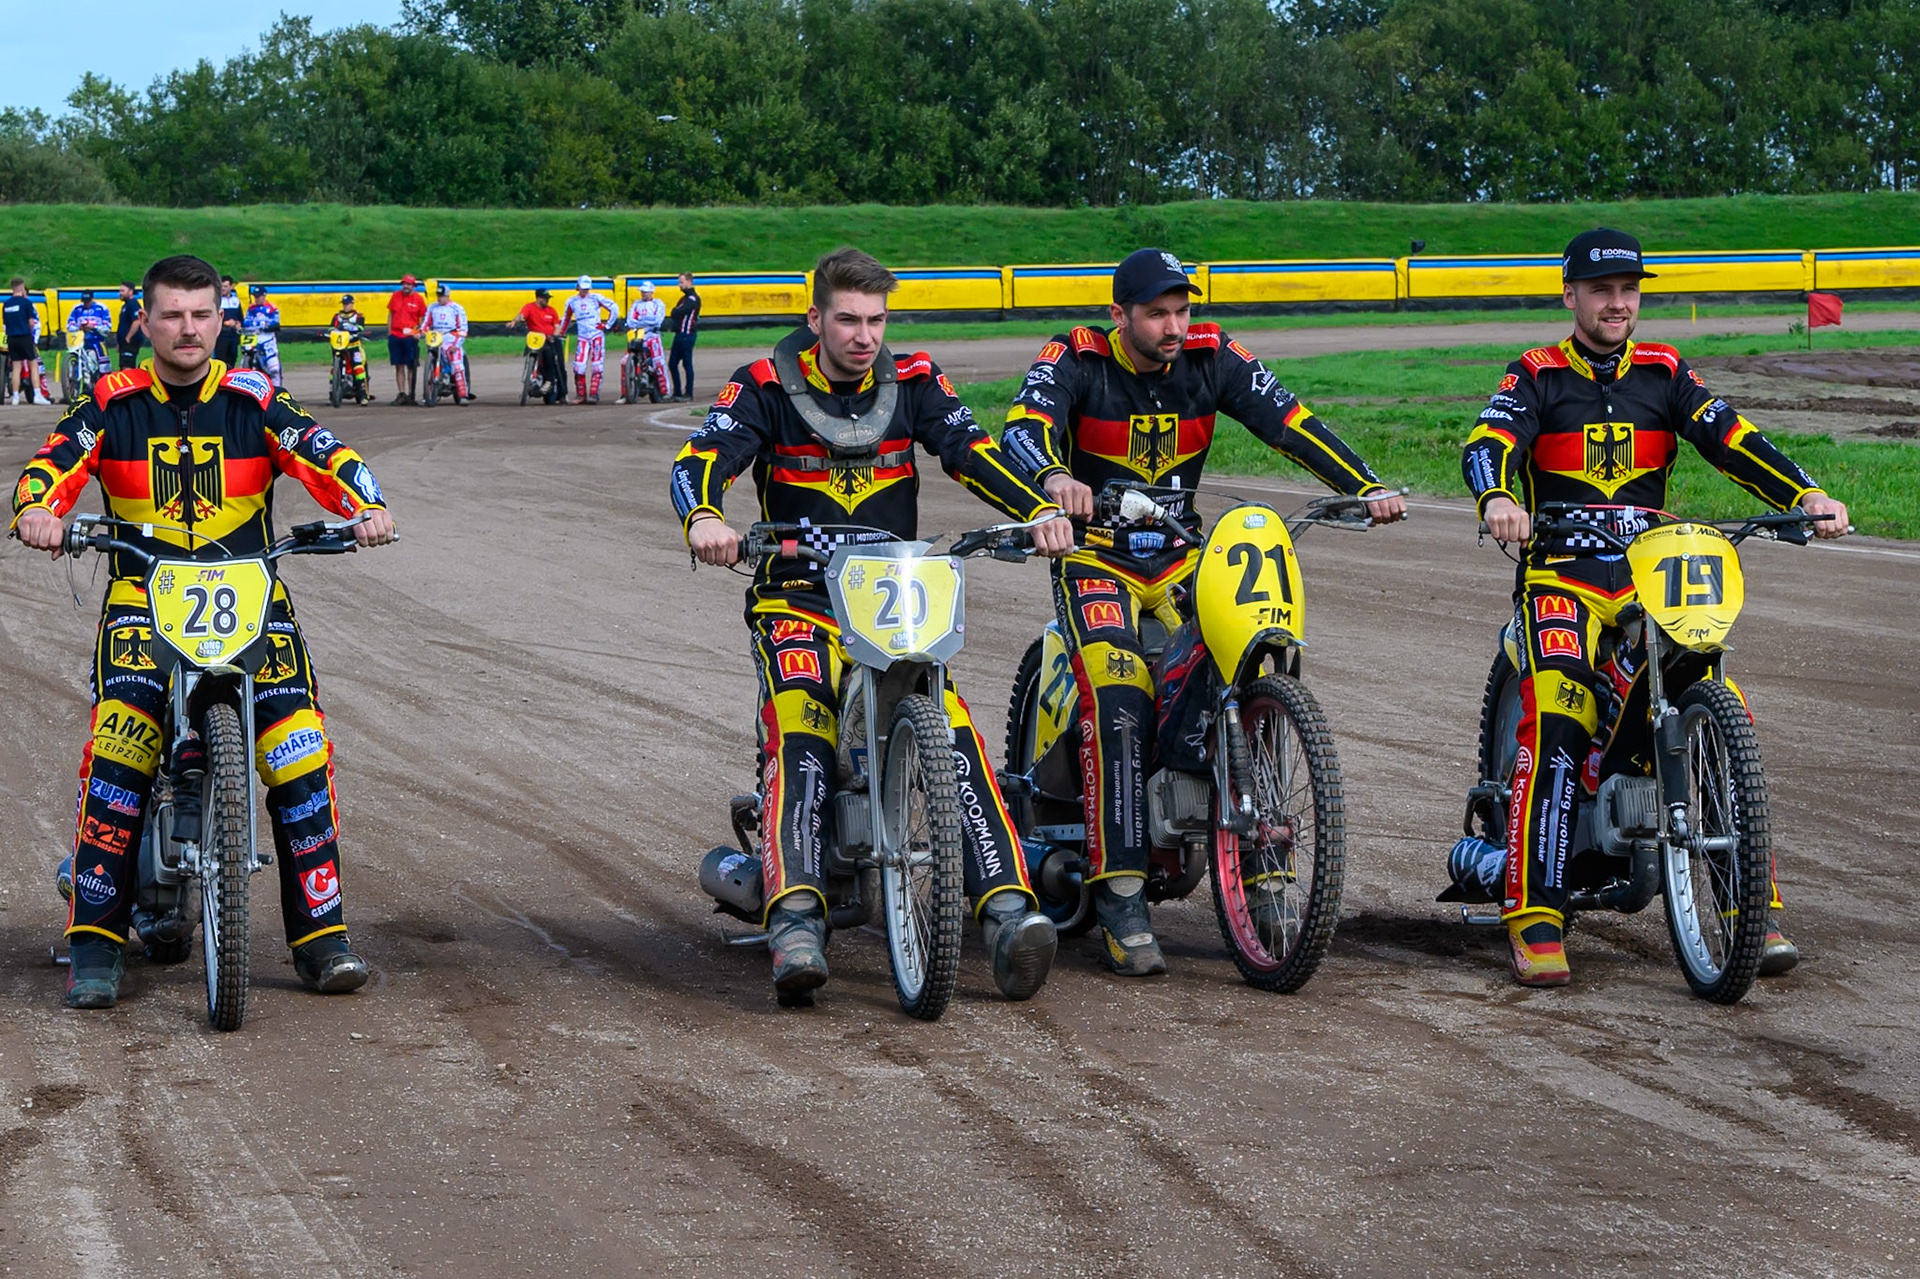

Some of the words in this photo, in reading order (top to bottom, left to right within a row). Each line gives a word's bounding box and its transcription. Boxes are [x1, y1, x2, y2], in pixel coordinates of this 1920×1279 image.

[1602, 248, 1637, 258] KOOPMANN
[336, 335, 343, 348] 4
[430, 331, 437, 343] 3
[1163, 500, 1185, 518] EAM
[1245, 514, 1265, 523] LONG
[1617, 518, 1650, 535] TEAM
[1643, 529, 1673, 541] KOOPMANN
[198, 569, 225, 582] FIM
[1227, 542, 1294, 607] 21
[1652, 555, 1723, 608] 19
[182, 584, 239, 638] 28
[874, 576, 929, 630] 20
[1256, 607, 1292, 625] FIM
[199, 640, 221, 650] LONG
[1687, 628, 1710, 638] FIM
[203, 648, 222, 656] TRACK
[105, 674, 164, 693] DEUTSCHLAND
[254, 686, 307, 703] EUTSCHLAND
[98, 712, 160, 752] AMZ
[98, 741, 144, 764] LEIPZIG
[265, 730, 324, 765] SCHÄFER
[1113, 760, 1122, 799] Insurance
[89, 776, 140, 810] ZUPIN
[1082, 747, 1097, 849] KOOPMANN
[1560, 777, 1576, 811] Jörg
[1115, 799, 1123, 826] Broker
[1539, 798, 1550, 836] Insurance
[960, 781, 1004, 879] KOOPMANN
[1507, 777, 1526, 884] KOOPMANN
[1538, 836, 1547, 863] Broker
[1556, 813, 1570, 889] Grohmann
[77, 873, 117, 897] oilfino
